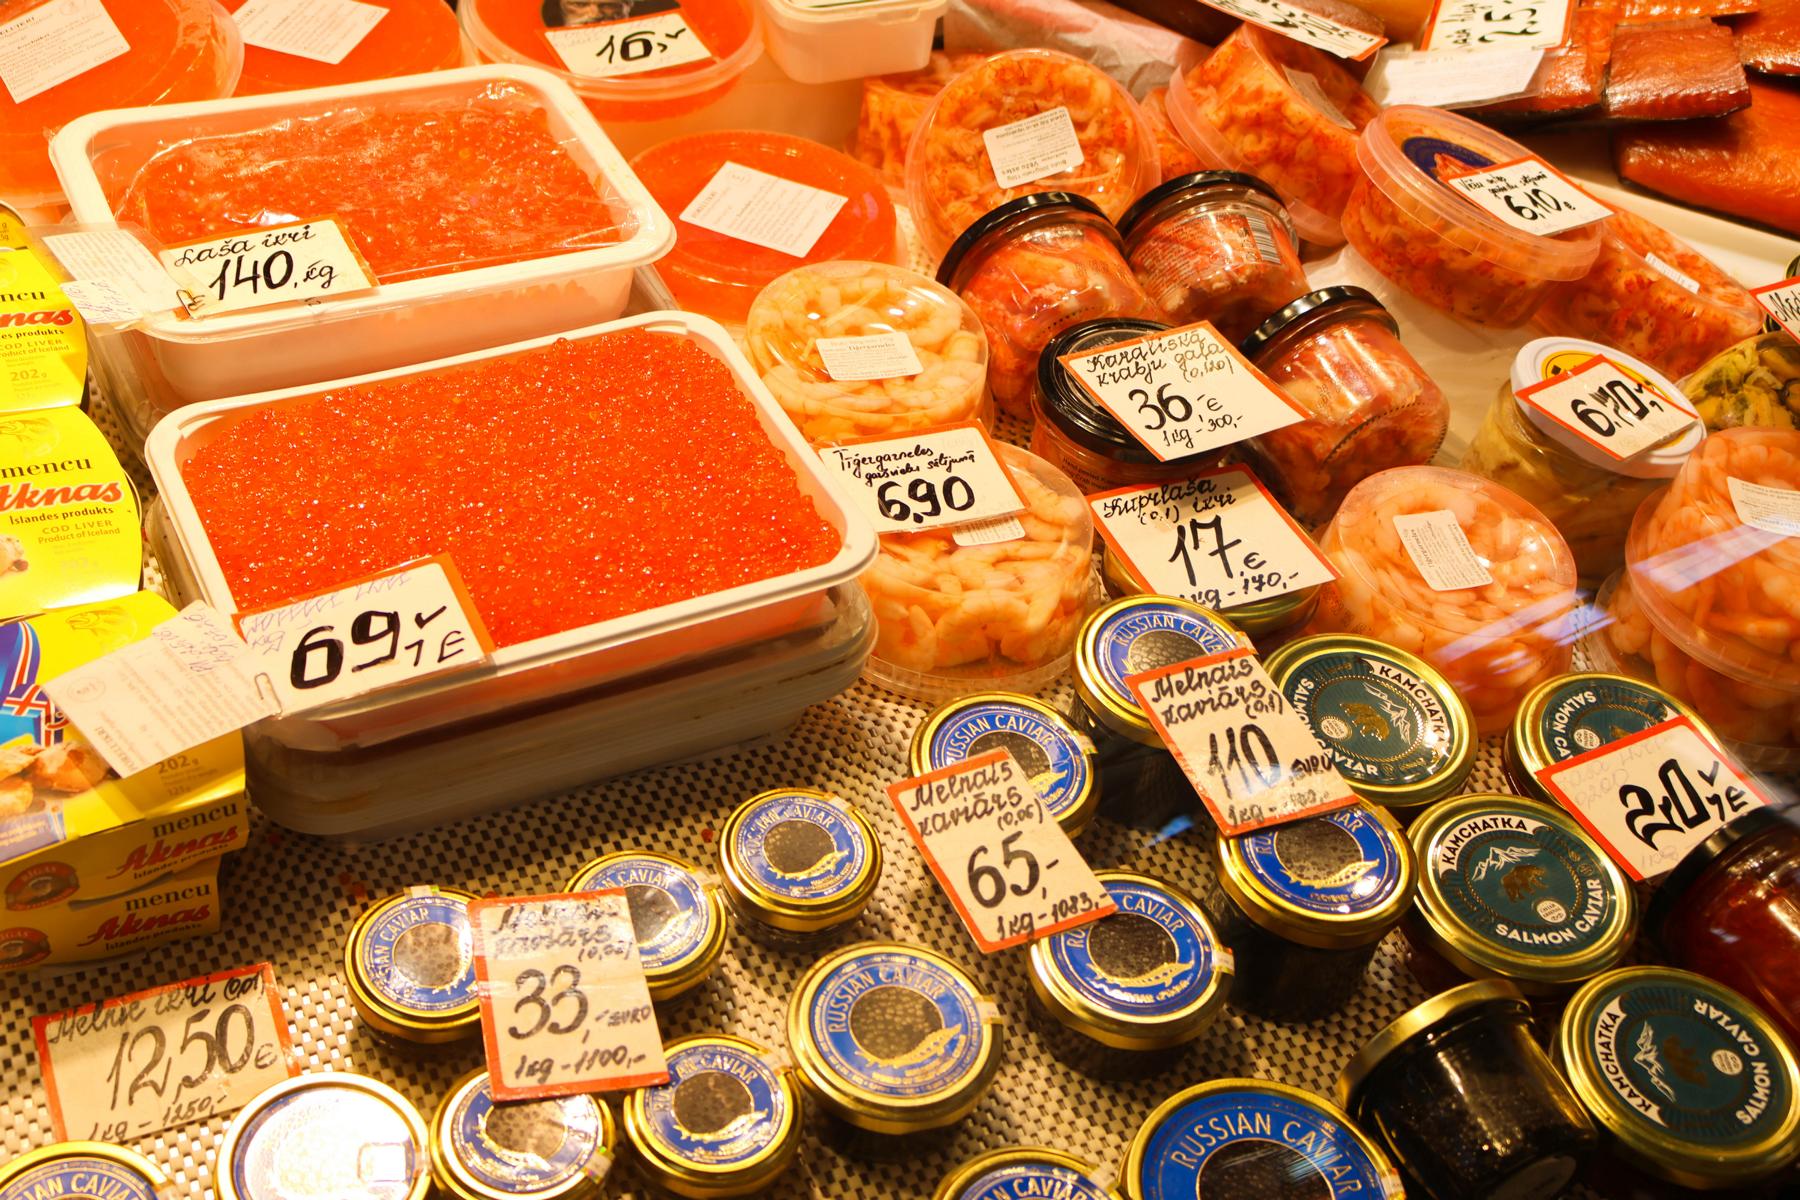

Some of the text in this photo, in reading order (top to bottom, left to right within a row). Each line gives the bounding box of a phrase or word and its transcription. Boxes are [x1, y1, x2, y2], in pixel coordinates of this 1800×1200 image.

[174, 224, 317, 267] Laša ikri
[15, 328, 65, 340] produkts
[28, 338, 63, 347] LIVER
[1096, 359, 1168, 388] krabju
[42, 519, 114, 536] COD LIVER
[61, 506, 115, 521] produkts
[38, 527, 121, 546] Product of Iceland
[1111, 614, 1228, 653] RUSSIAN CAVIA
[1151, 657, 1255, 704] Melnais
[994, 714, 1057, 747] CAVIAR
[1552, 690, 1598, 734] SALMON
[158, 754, 190, 774] 202
[910, 760, 1013, 812] Melnais
[151, 802, 239, 839] mencu
[1441, 817, 1528, 866] KAMCHATKA
[124, 882, 212, 913] mencu
[1121, 894, 1186, 934] CAVIAR
[1495, 922, 1577, 946] SALMON
[1574, 878, 1602, 934] CAVIAR
[379, 907, 431, 943] CAVIAR
[828, 965, 948, 1034] RUSSIAN CAVIAR
[1693, 998, 1761, 1057] CAVIAR
[700, 1053, 759, 1085] CAVIAR
[1599, 1010, 1653, 1113] KAMCHATKA
[1735, 1061, 1773, 1126] SALMON
[1170, 1111, 1364, 1196] RUSSIAN CAVIAR
